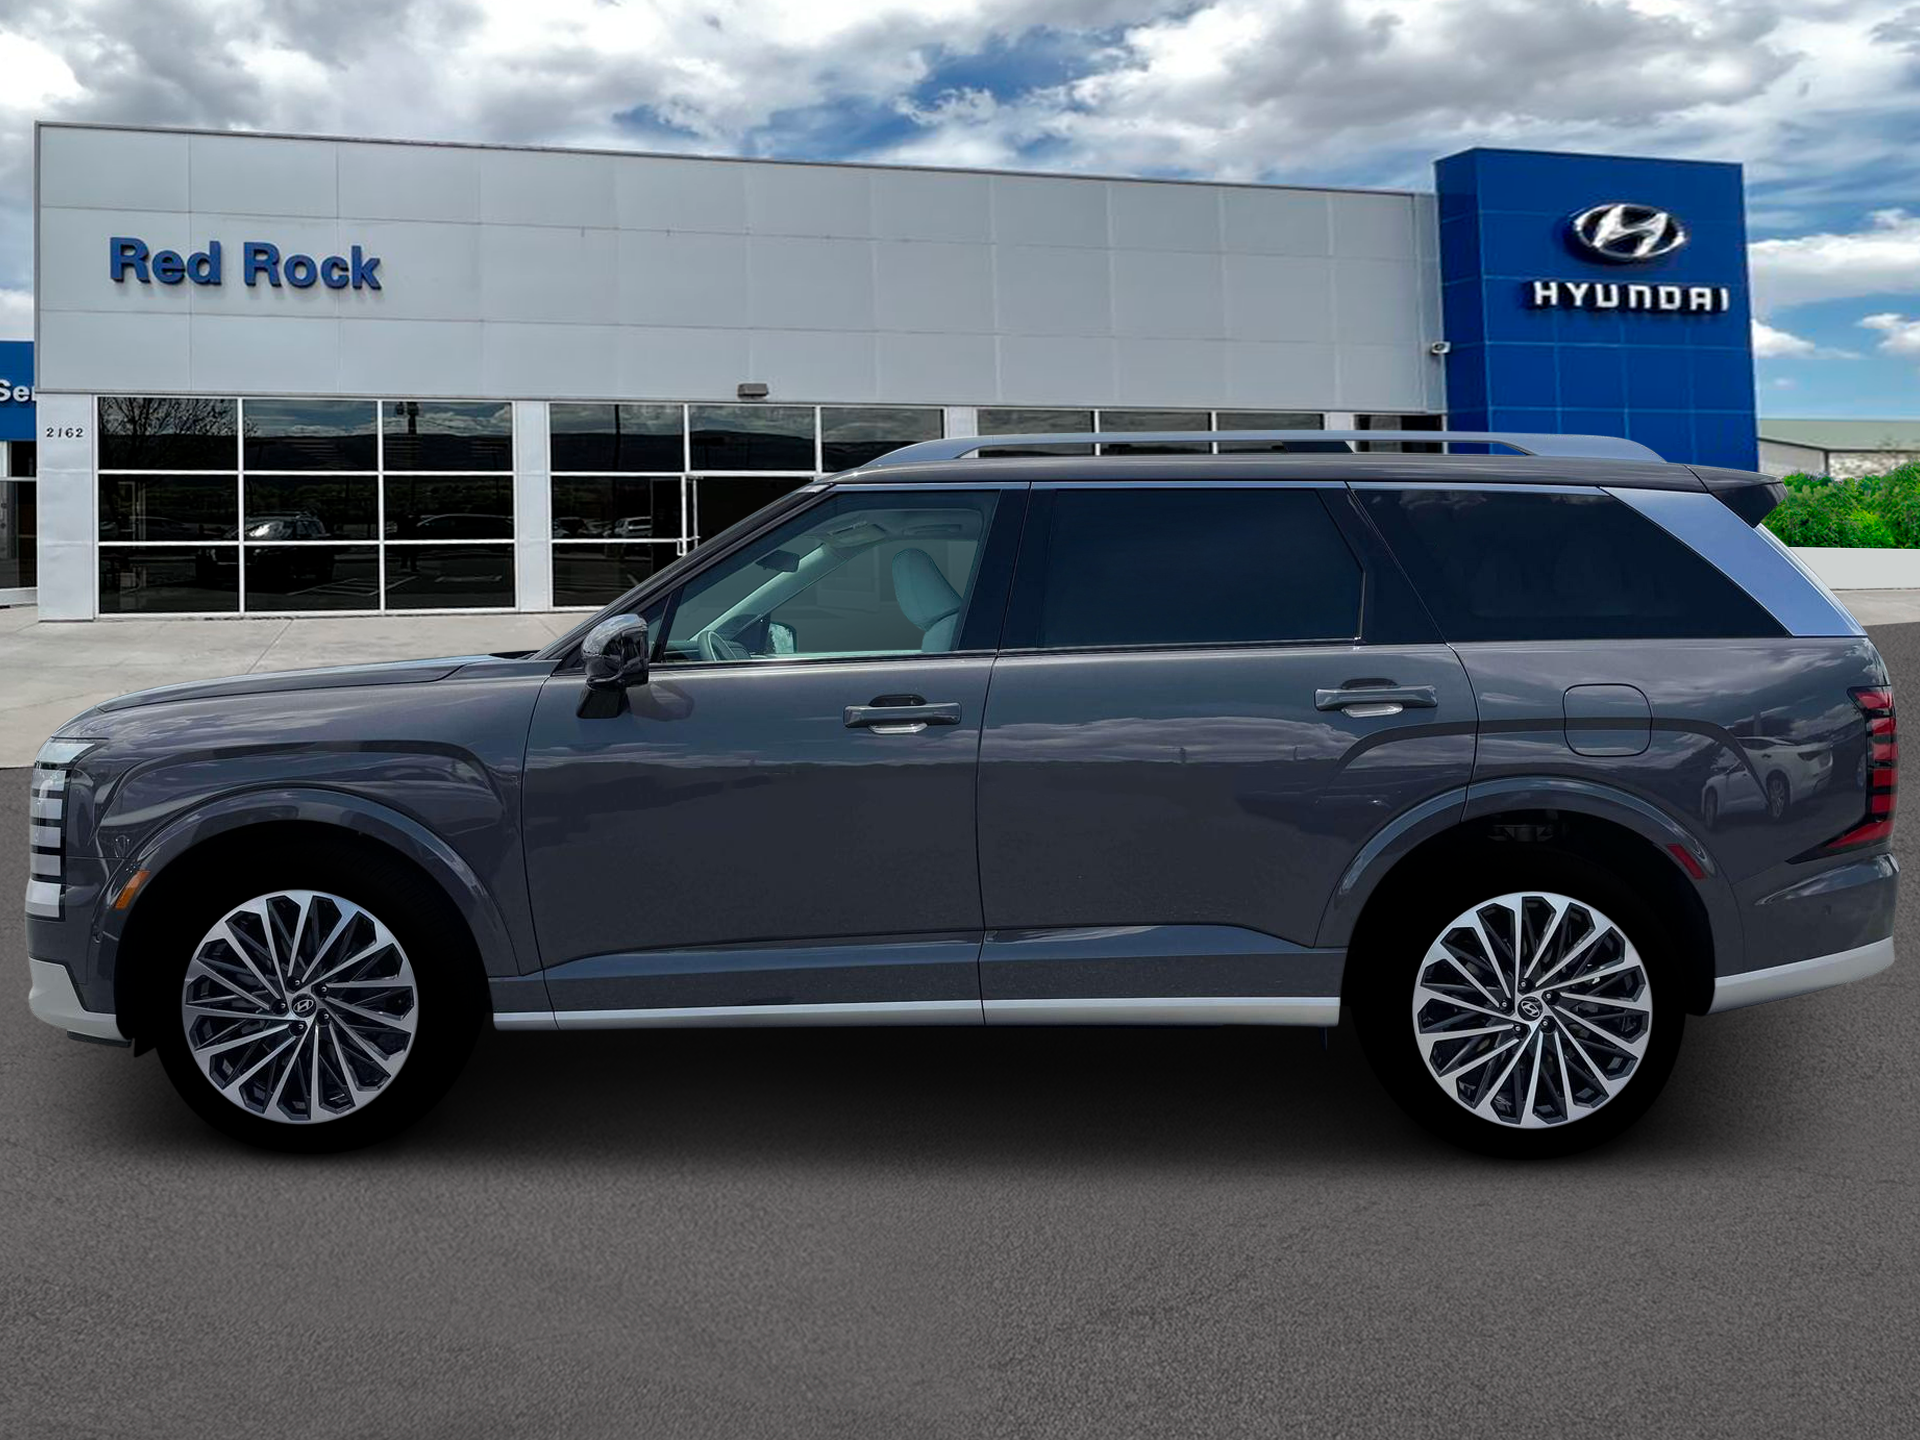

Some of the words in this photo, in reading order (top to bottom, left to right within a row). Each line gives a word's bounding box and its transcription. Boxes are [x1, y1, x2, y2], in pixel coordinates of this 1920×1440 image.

[110, 237, 222, 285] Red
[243, 241, 382, 290] Rock
[1534, 280, 1730, 312] HYUNDAI
[46, 427, 84, 438] 2162
